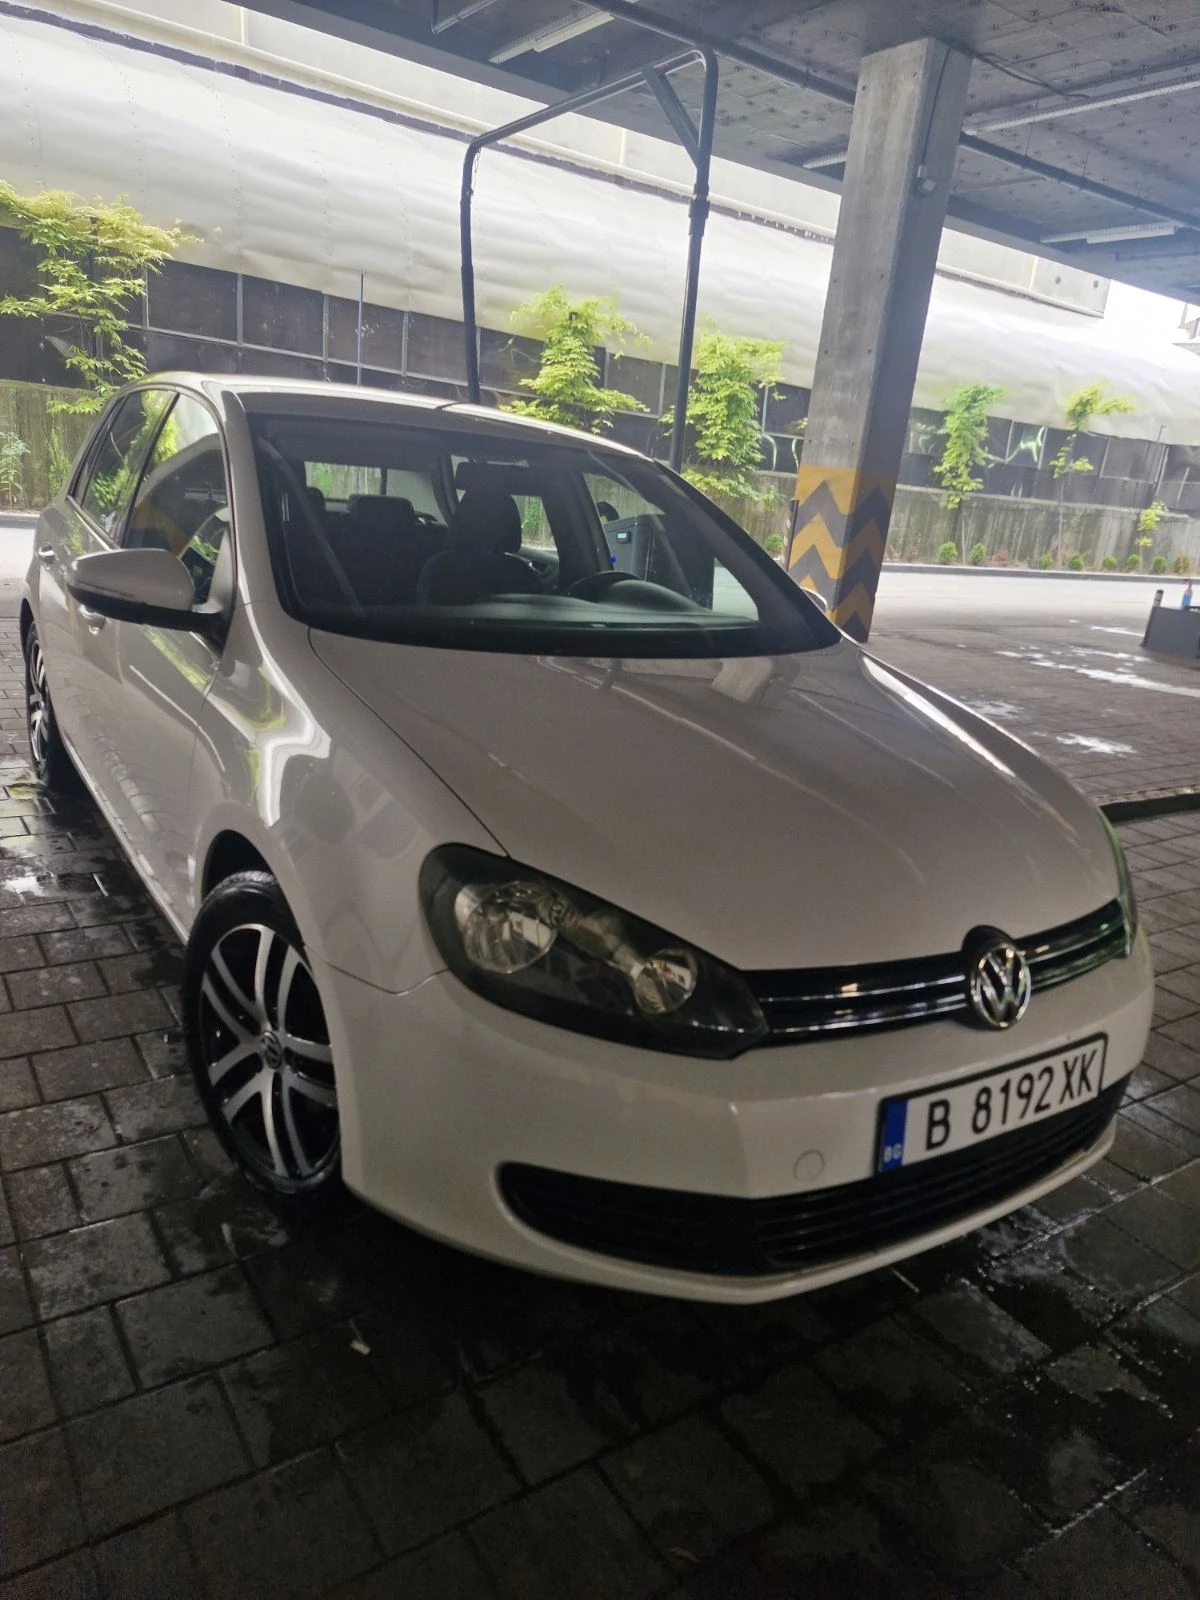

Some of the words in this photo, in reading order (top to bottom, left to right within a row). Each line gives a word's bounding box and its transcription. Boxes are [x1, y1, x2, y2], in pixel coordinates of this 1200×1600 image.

[926, 1098, 951, 1152] B
[971, 1065, 1055, 1135] 8192
[1058, 1048, 1098, 1105] XK
